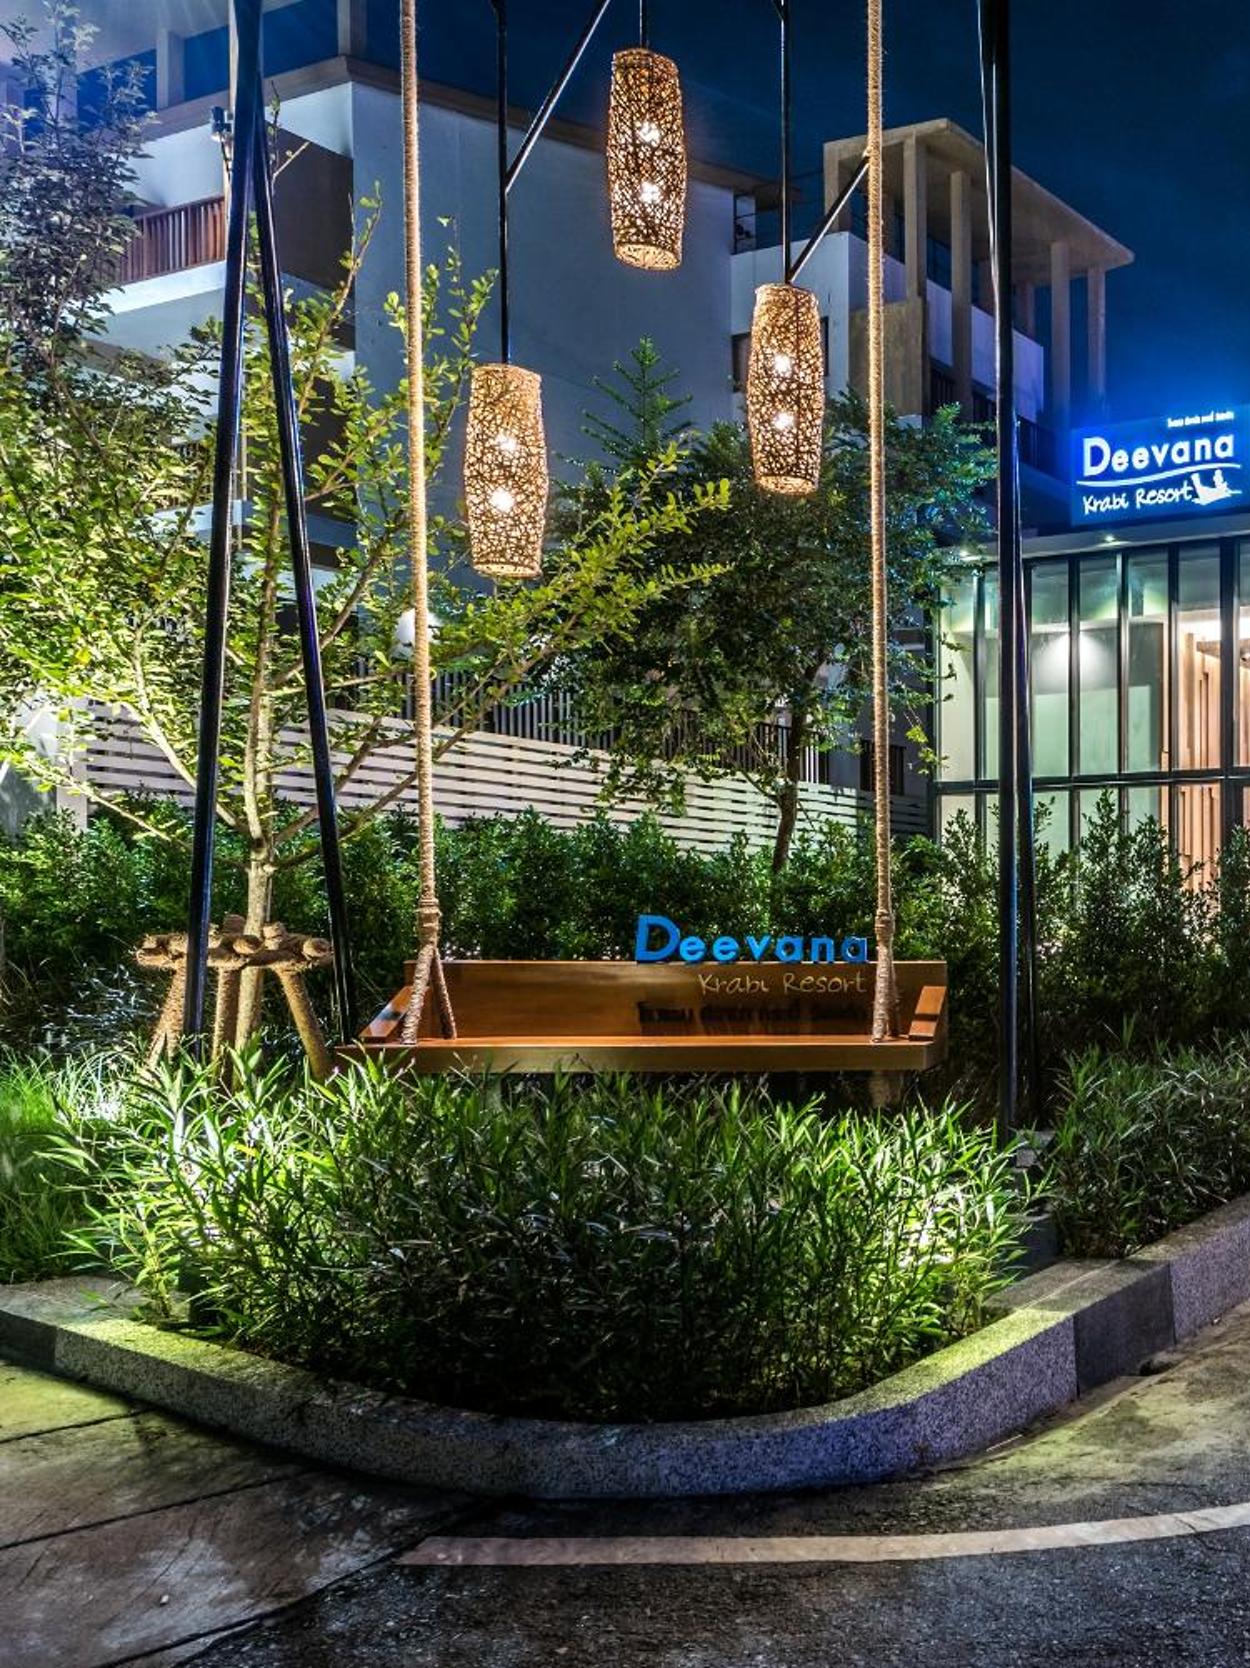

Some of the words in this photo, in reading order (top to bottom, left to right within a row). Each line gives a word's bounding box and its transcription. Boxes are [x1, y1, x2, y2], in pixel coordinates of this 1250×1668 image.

[1083, 434, 1235, 477] Deevana
[1083, 492, 1129, 515] Krabi
[1136, 481, 1193, 509] Resort
[635, 914, 869, 963] Deevana
[782, 972, 867, 993] Resort
